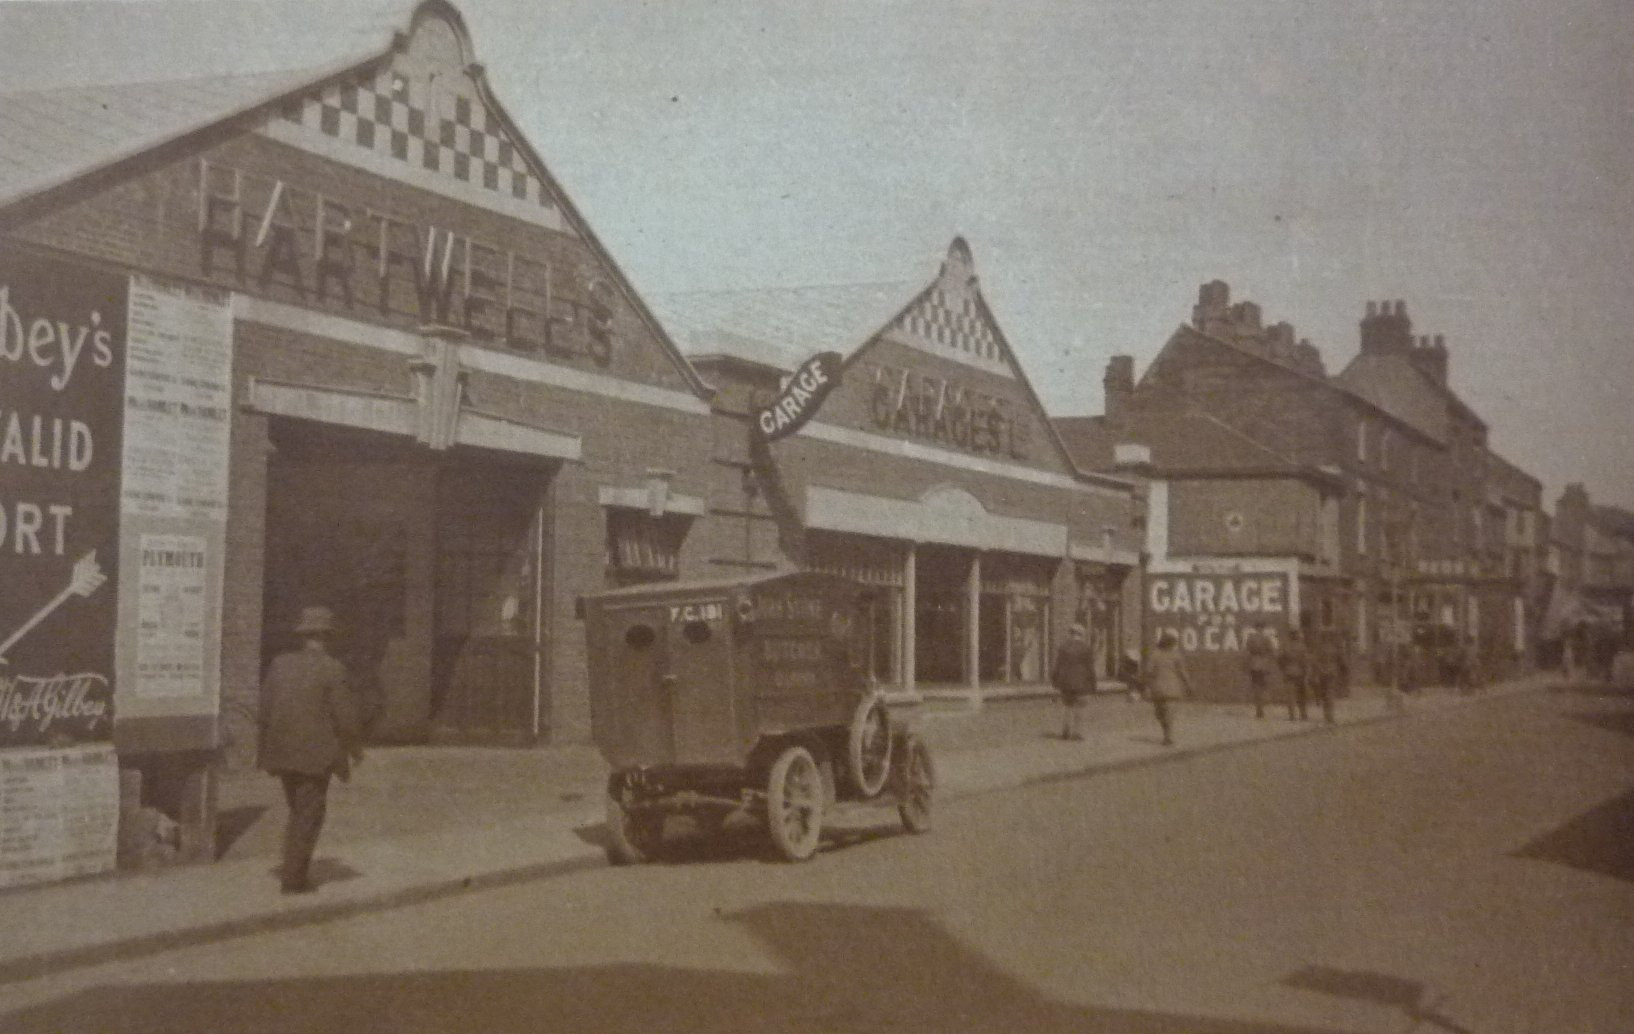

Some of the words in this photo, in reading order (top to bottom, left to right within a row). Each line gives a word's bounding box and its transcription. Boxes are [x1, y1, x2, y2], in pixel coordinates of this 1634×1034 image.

[200, 158, 614, 362] HARTWELLS
[759, 360, 828, 434] GARAGE
[0, 409, 93, 471] ALID
[1151, 578, 1283, 613] GARAGE
